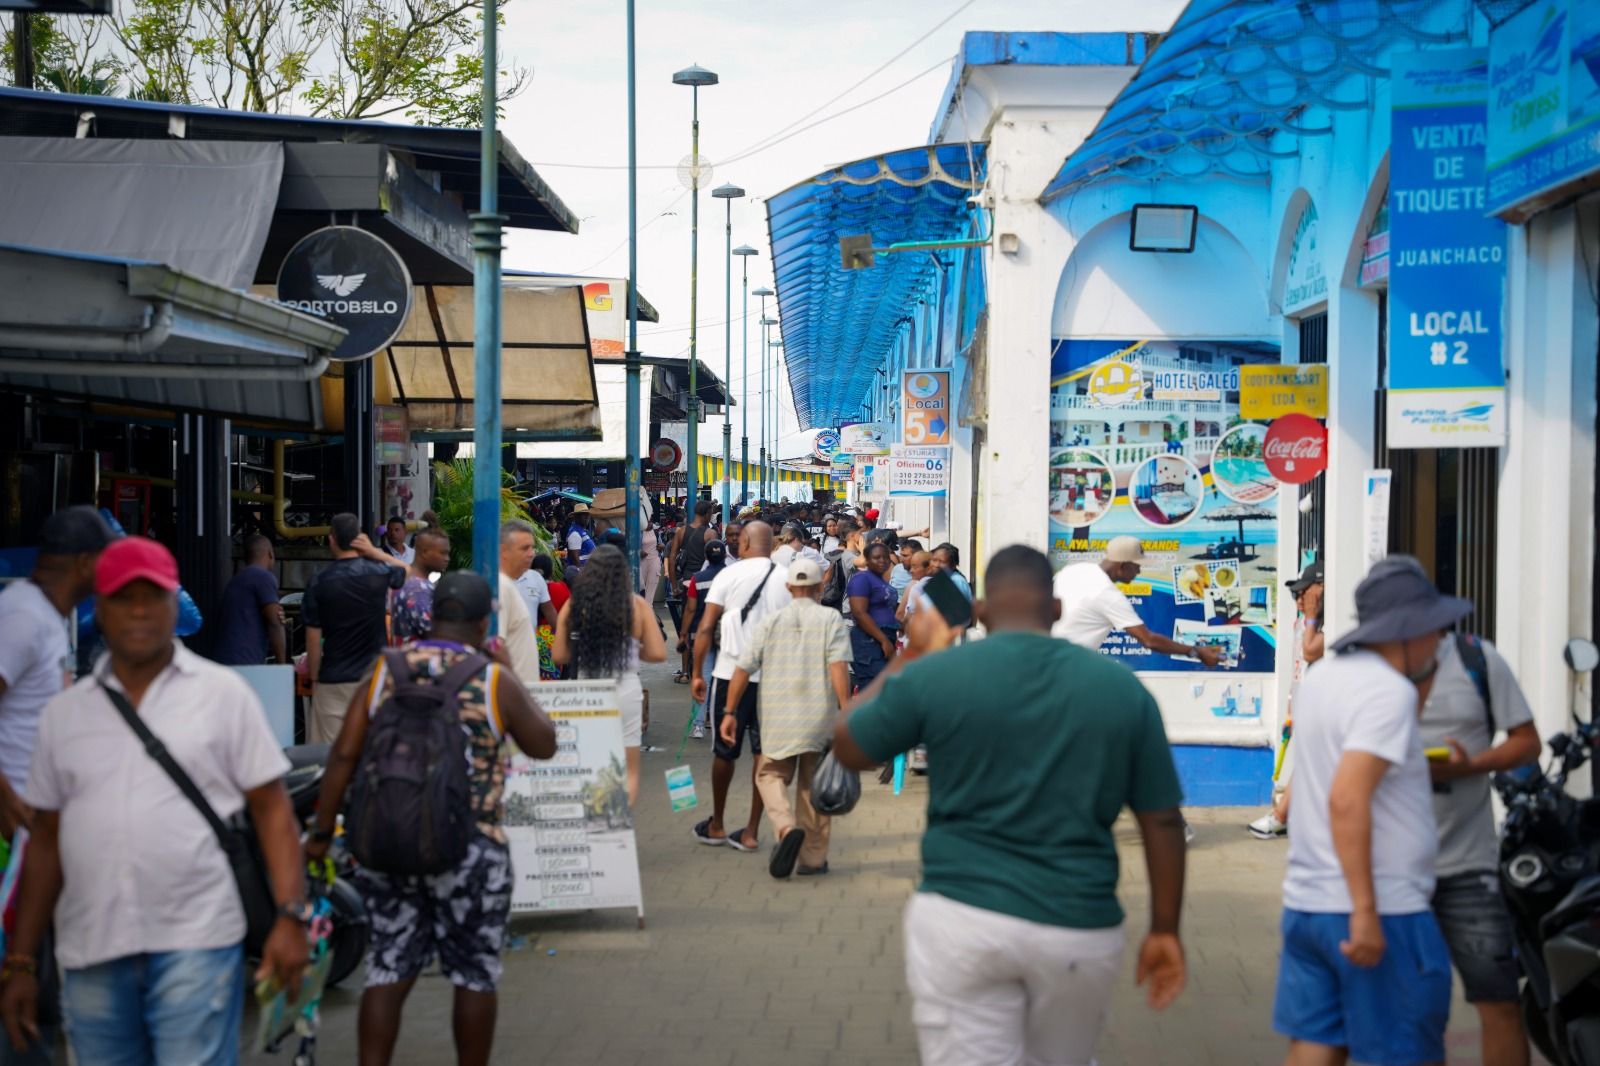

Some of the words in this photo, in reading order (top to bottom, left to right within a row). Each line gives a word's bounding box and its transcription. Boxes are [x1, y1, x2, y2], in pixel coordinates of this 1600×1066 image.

[1411, 123, 1488, 149] VENTA
[1433, 156, 1464, 180] DE
[1393, 187, 1486, 214] TIQUETE
[1396, 245, 1503, 267] JUANCHACO
[1409, 310, 1490, 337] LOCAL
[1154, 373, 1195, 390] HOTEL
[1198, 367, 1239, 390] GALEÓ
[906, 397, 944, 409] Local
[1271, 393, 1296, 406] LTDA
[905, 411, 926, 444] 5
[896, 460, 925, 469] Oficina
[926, 459, 943, 471] 06
[1055, 538, 1089, 551] PLAYA
[1090, 539, 1109, 551] PIA
[1110, 647, 1121, 655] de
[1122, 647, 1152, 656] Lancha
